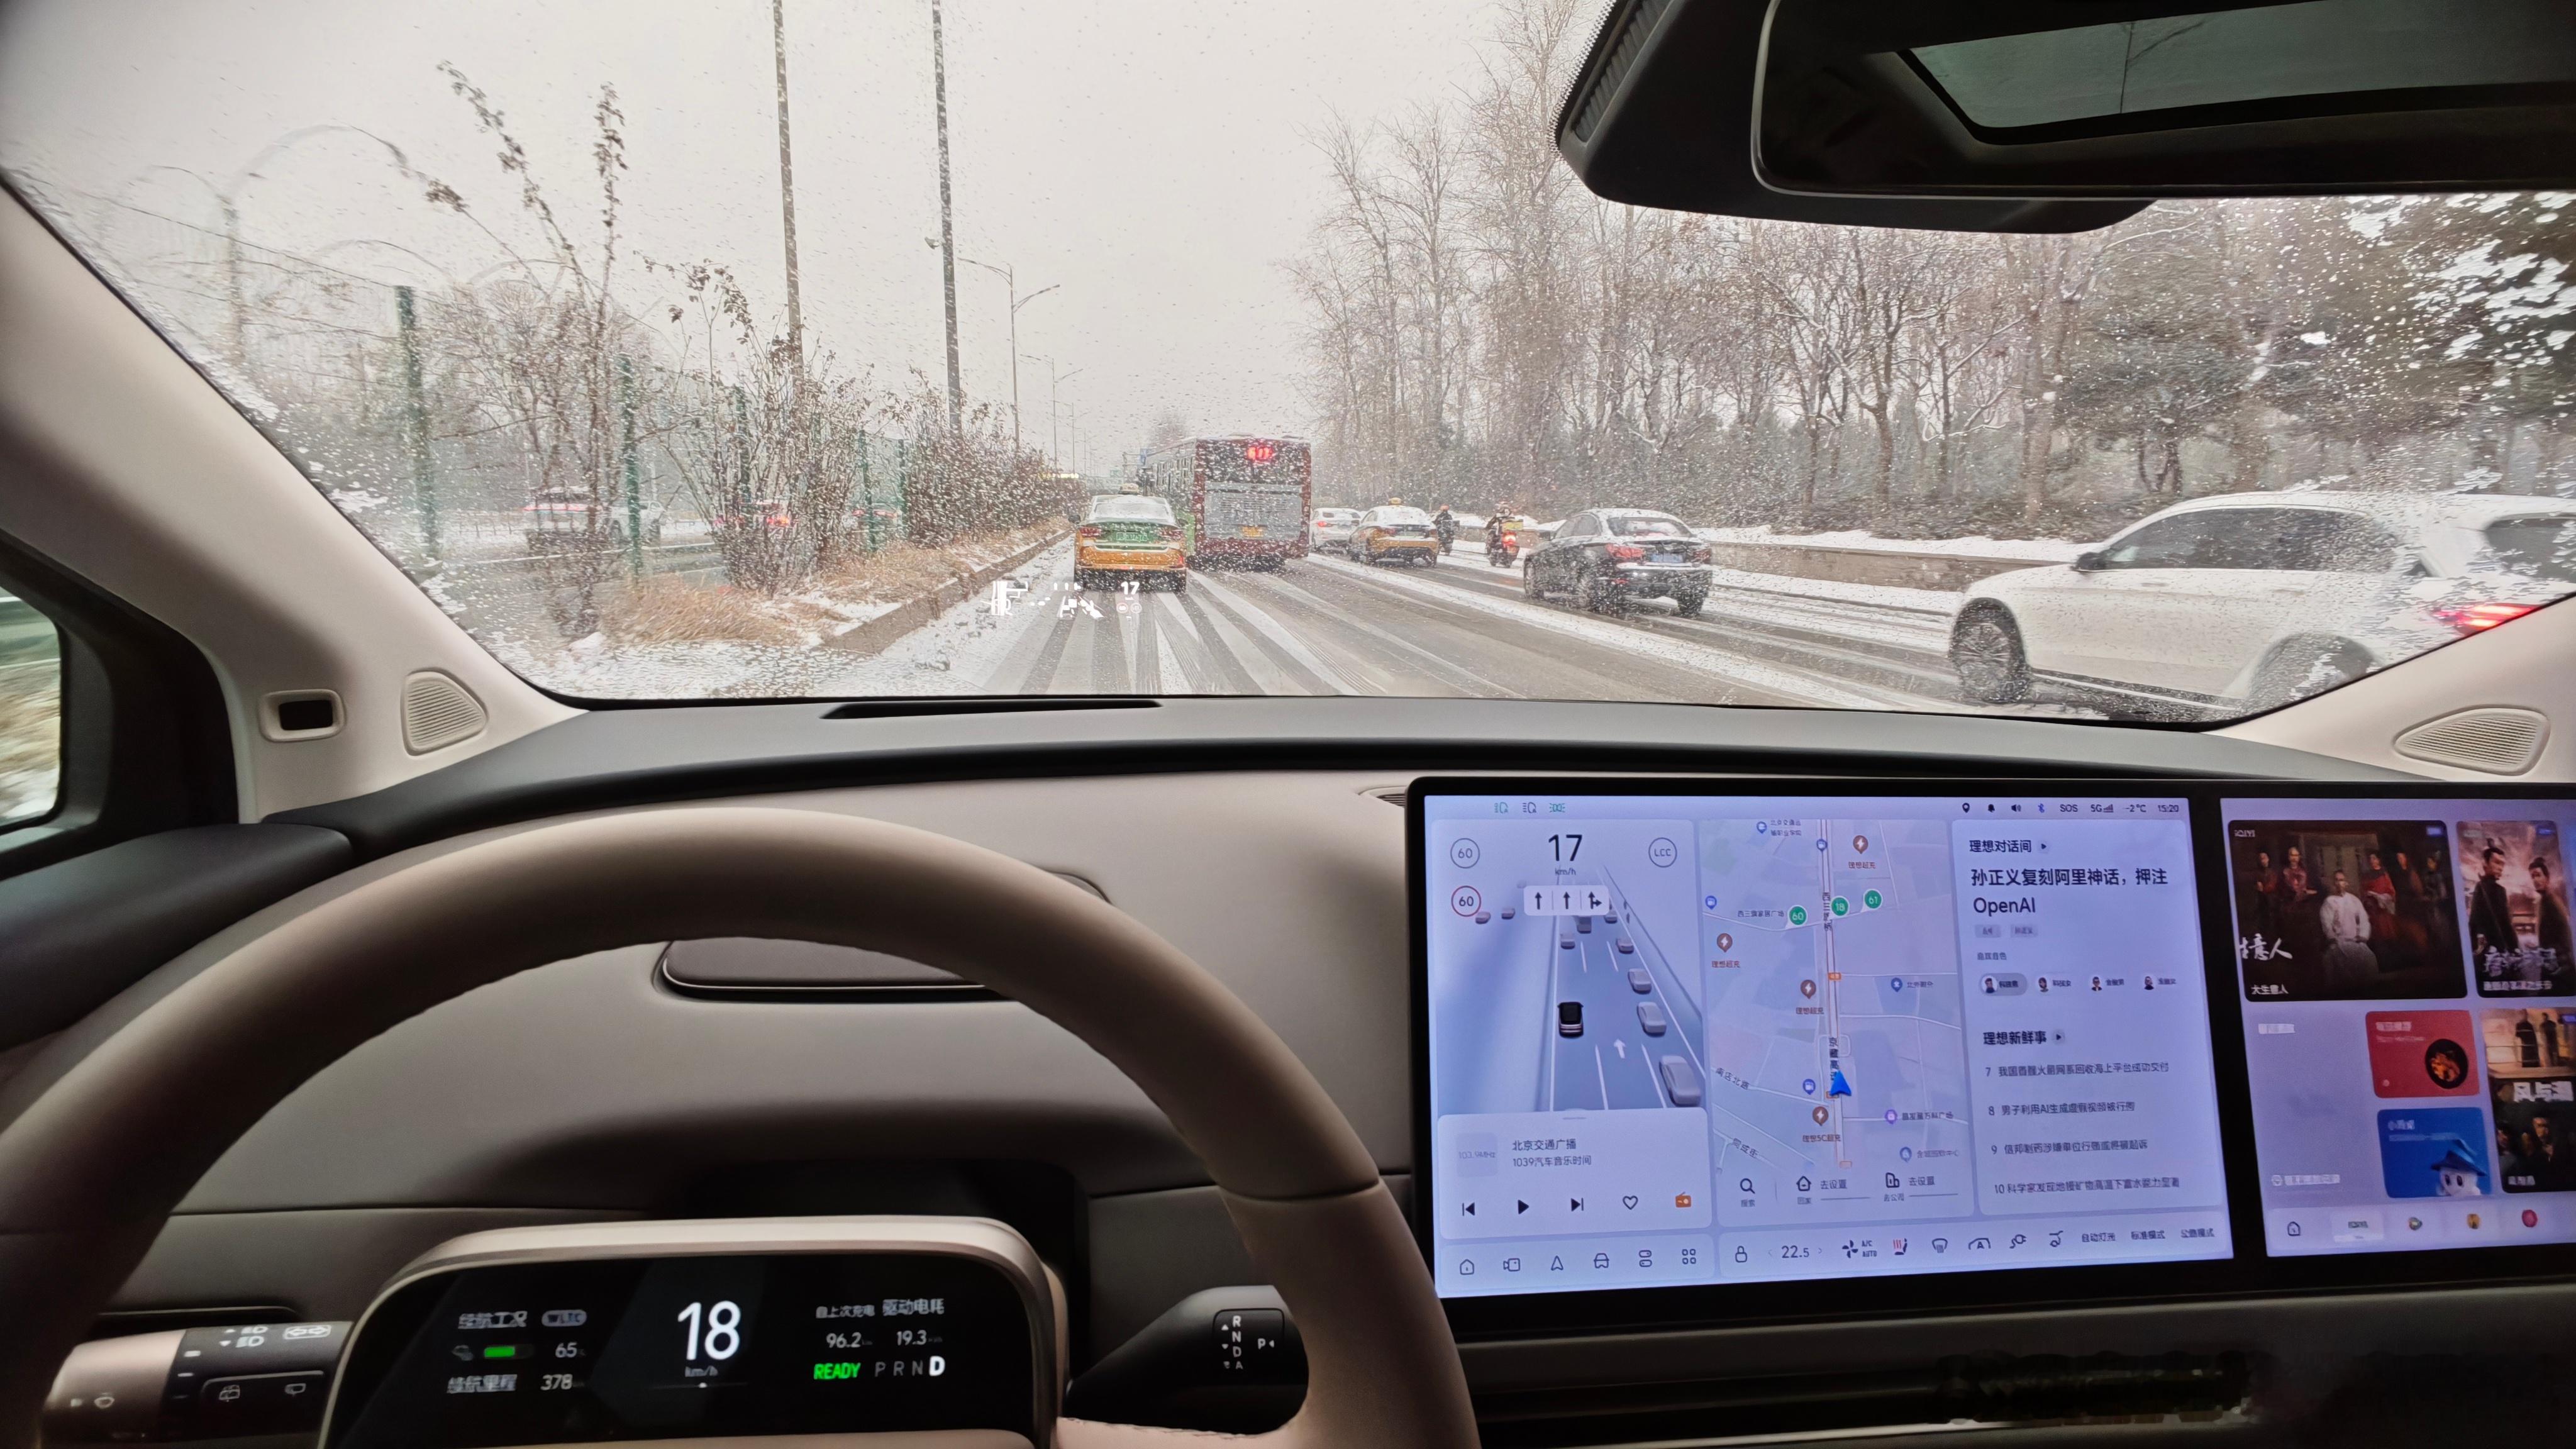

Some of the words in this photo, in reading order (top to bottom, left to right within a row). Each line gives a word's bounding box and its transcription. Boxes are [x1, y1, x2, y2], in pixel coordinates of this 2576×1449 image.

[1121, 581, 1140, 594] 17
[2060, 804, 2078, 813] SOS
[2090, 804, 2102, 813] 5G
[2158, 804, 2179, 813] 15:20
[1548, 834, 1583, 862] 17
[1654, 848, 1672, 857] LCC
[1969, 840, 2032, 853] 理想对话间
[1458, 848, 1473, 858] 60
[1555, 868, 1577, 876] km/h
[1971, 868, 2168, 887] 孙正义复刻阿里神话，押注
[1458, 896, 1474, 907] 60
[1868, 896, 1879, 905] 61
[1835, 902, 1846, 912] 18
[1974, 897, 2036, 917] OpenAI
[1792, 912, 1804, 921] 60
[1983, 1031, 2047, 1045] 理想新鲜事
[1985, 1067, 1991, 1077] 7
[1988, 1106, 1995, 1116] 8
[1512, 1138, 1577, 1151] 北京交通广播
[1991, 1145, 1997, 1155] 9
[1513, 1155, 1592, 1168] 1039汽车音乐时间
[1994, 1184, 2005, 1194] 10
[1781, 1245, 1810, 1258] 22.5
[882, 1298, 945, 1316] 驱动电耗
[1233, 1315, 1241, 1328] R
[677, 1300, 741, 1361] 18
[1232, 1331, 1241, 1342] N
[826, 1331, 862, 1348] 96.2
[896, 1330, 927, 1346] 19.3
[1258, 1338, 1266, 1350] P
[555, 1341, 577, 1358] 65
[1233, 1346, 1241, 1357] D
[685, 1366, 718, 1377] km/h
[813, 1362, 861, 1380] READY
[875, 1361, 886, 1377] P
[893, 1360, 905, 1376] R
[911, 1360, 924, 1376] N
[929, 1355, 946, 1377] D
[540, 1373, 573, 1391] 378
